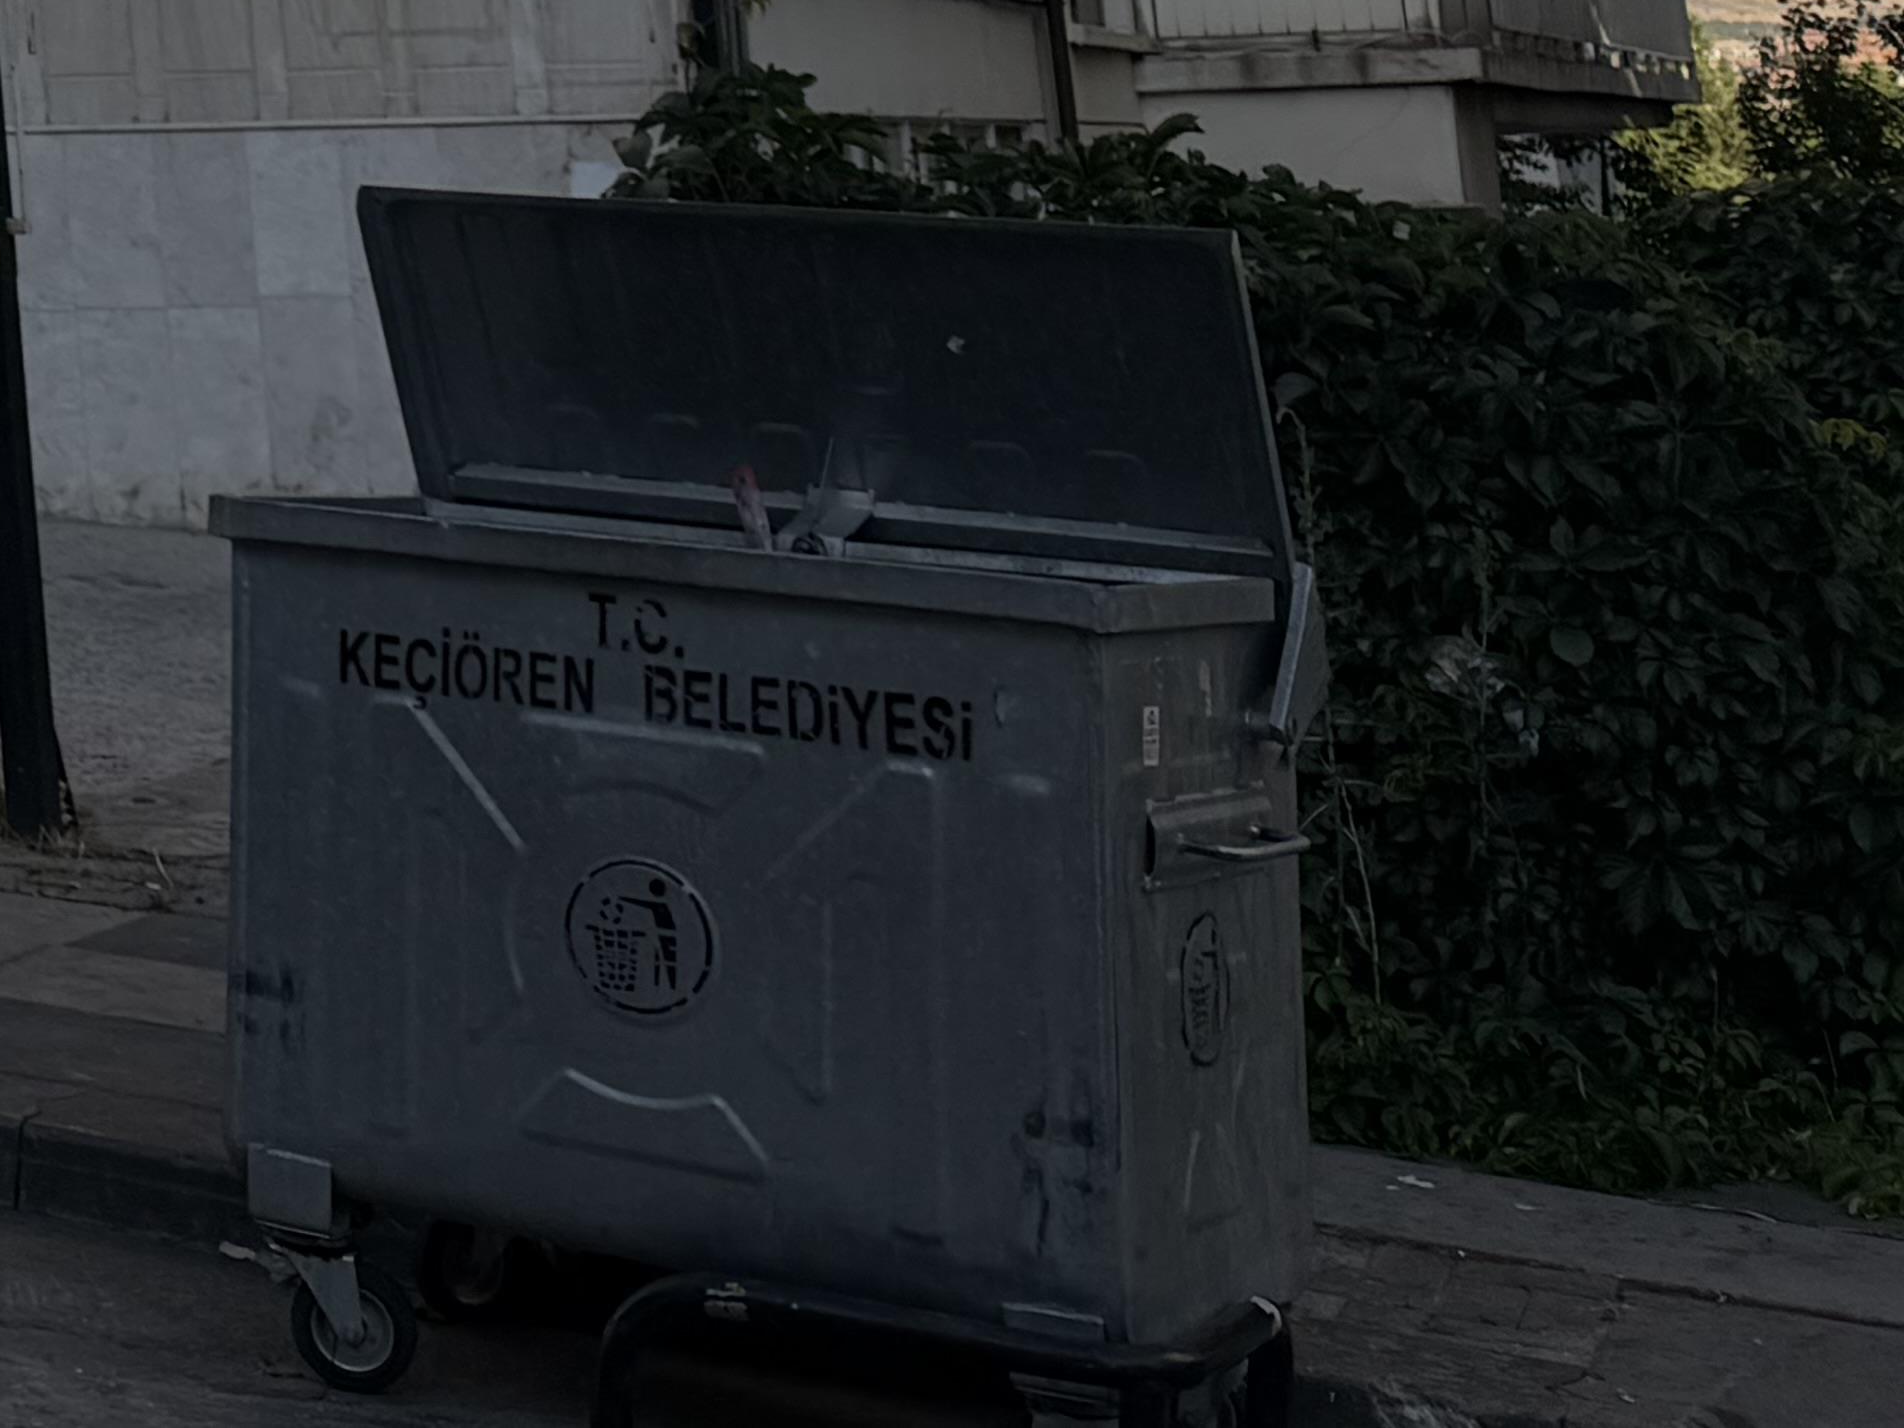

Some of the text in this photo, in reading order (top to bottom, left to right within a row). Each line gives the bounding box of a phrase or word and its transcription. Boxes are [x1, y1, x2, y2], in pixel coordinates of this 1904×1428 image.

[589, 593, 684, 658] T.C.
[338, 627, 973, 762] KEÇİÖREN BELEDİYESİ
